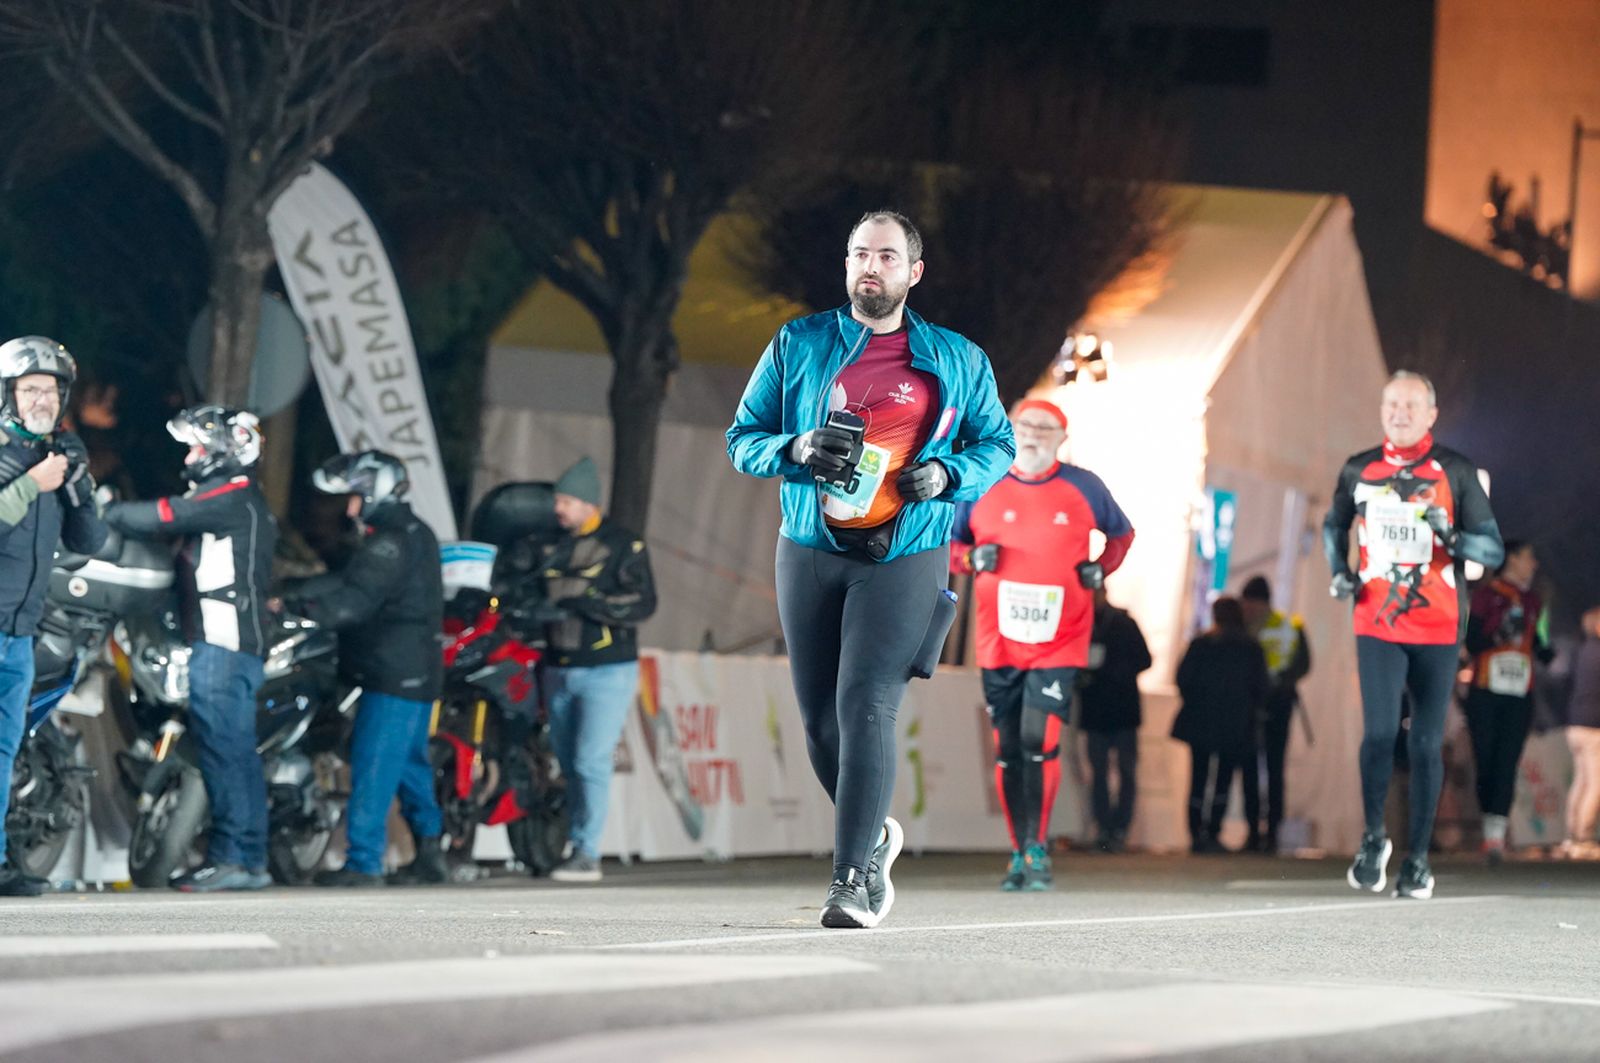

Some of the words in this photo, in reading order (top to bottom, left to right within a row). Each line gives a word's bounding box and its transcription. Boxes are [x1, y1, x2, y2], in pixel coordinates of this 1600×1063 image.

[331, 219, 431, 466] JAPEMASA
[1381, 525, 1416, 541] 7691
[1010, 605, 1049, 622] 5304
